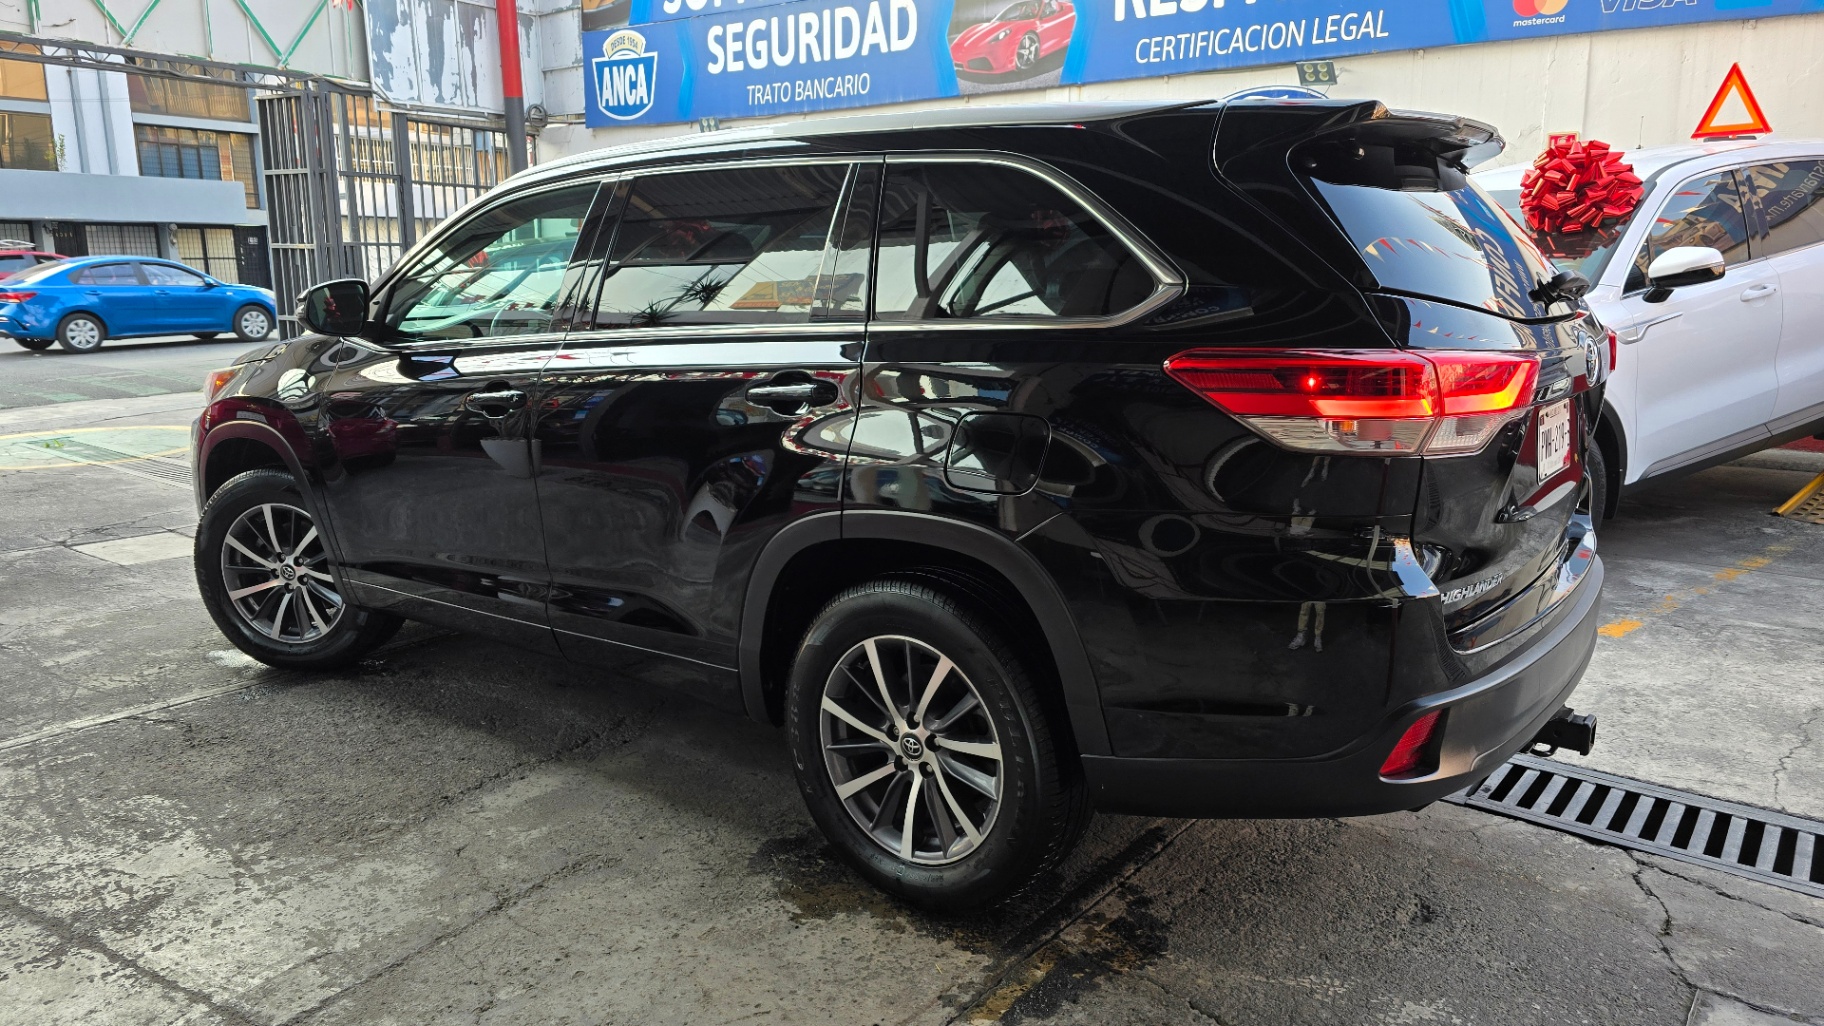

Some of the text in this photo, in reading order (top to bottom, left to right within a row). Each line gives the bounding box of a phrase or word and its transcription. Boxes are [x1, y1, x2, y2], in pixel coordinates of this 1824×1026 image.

[707, 0, 918, 74] SEGURIDAD
[1135, 20, 1306, 63] CERTIFICACION
[1312, 10, 1389, 45] LEGAL
[1513, 15, 1566, 28] mastercard
[610, 35, 626, 51] DESDE
[602, 63, 649, 107] ANCA
[747, 72, 871, 105] TRATO BANCARIO
[1440, 572, 1503, 605] HIGHLANDER
